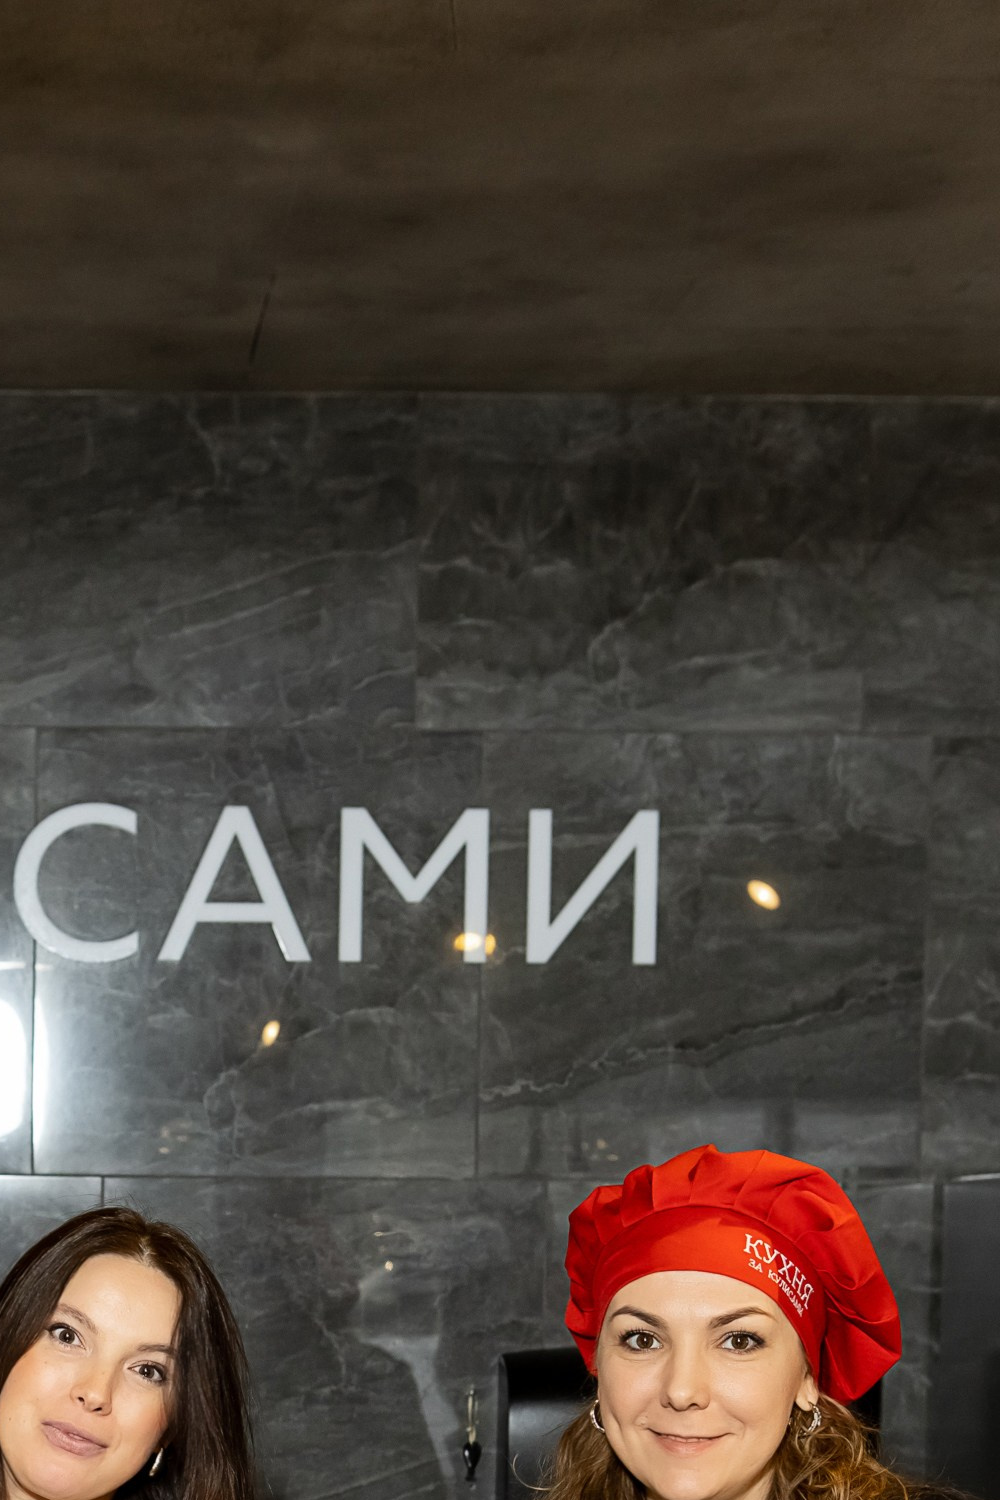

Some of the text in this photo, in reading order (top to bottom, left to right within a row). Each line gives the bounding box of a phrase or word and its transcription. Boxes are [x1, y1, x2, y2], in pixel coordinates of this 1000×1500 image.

[743, 1233, 815, 1310] КУХНЯ
[748, 1258, 805, 1318] ЗА КУЛИСАМИ
